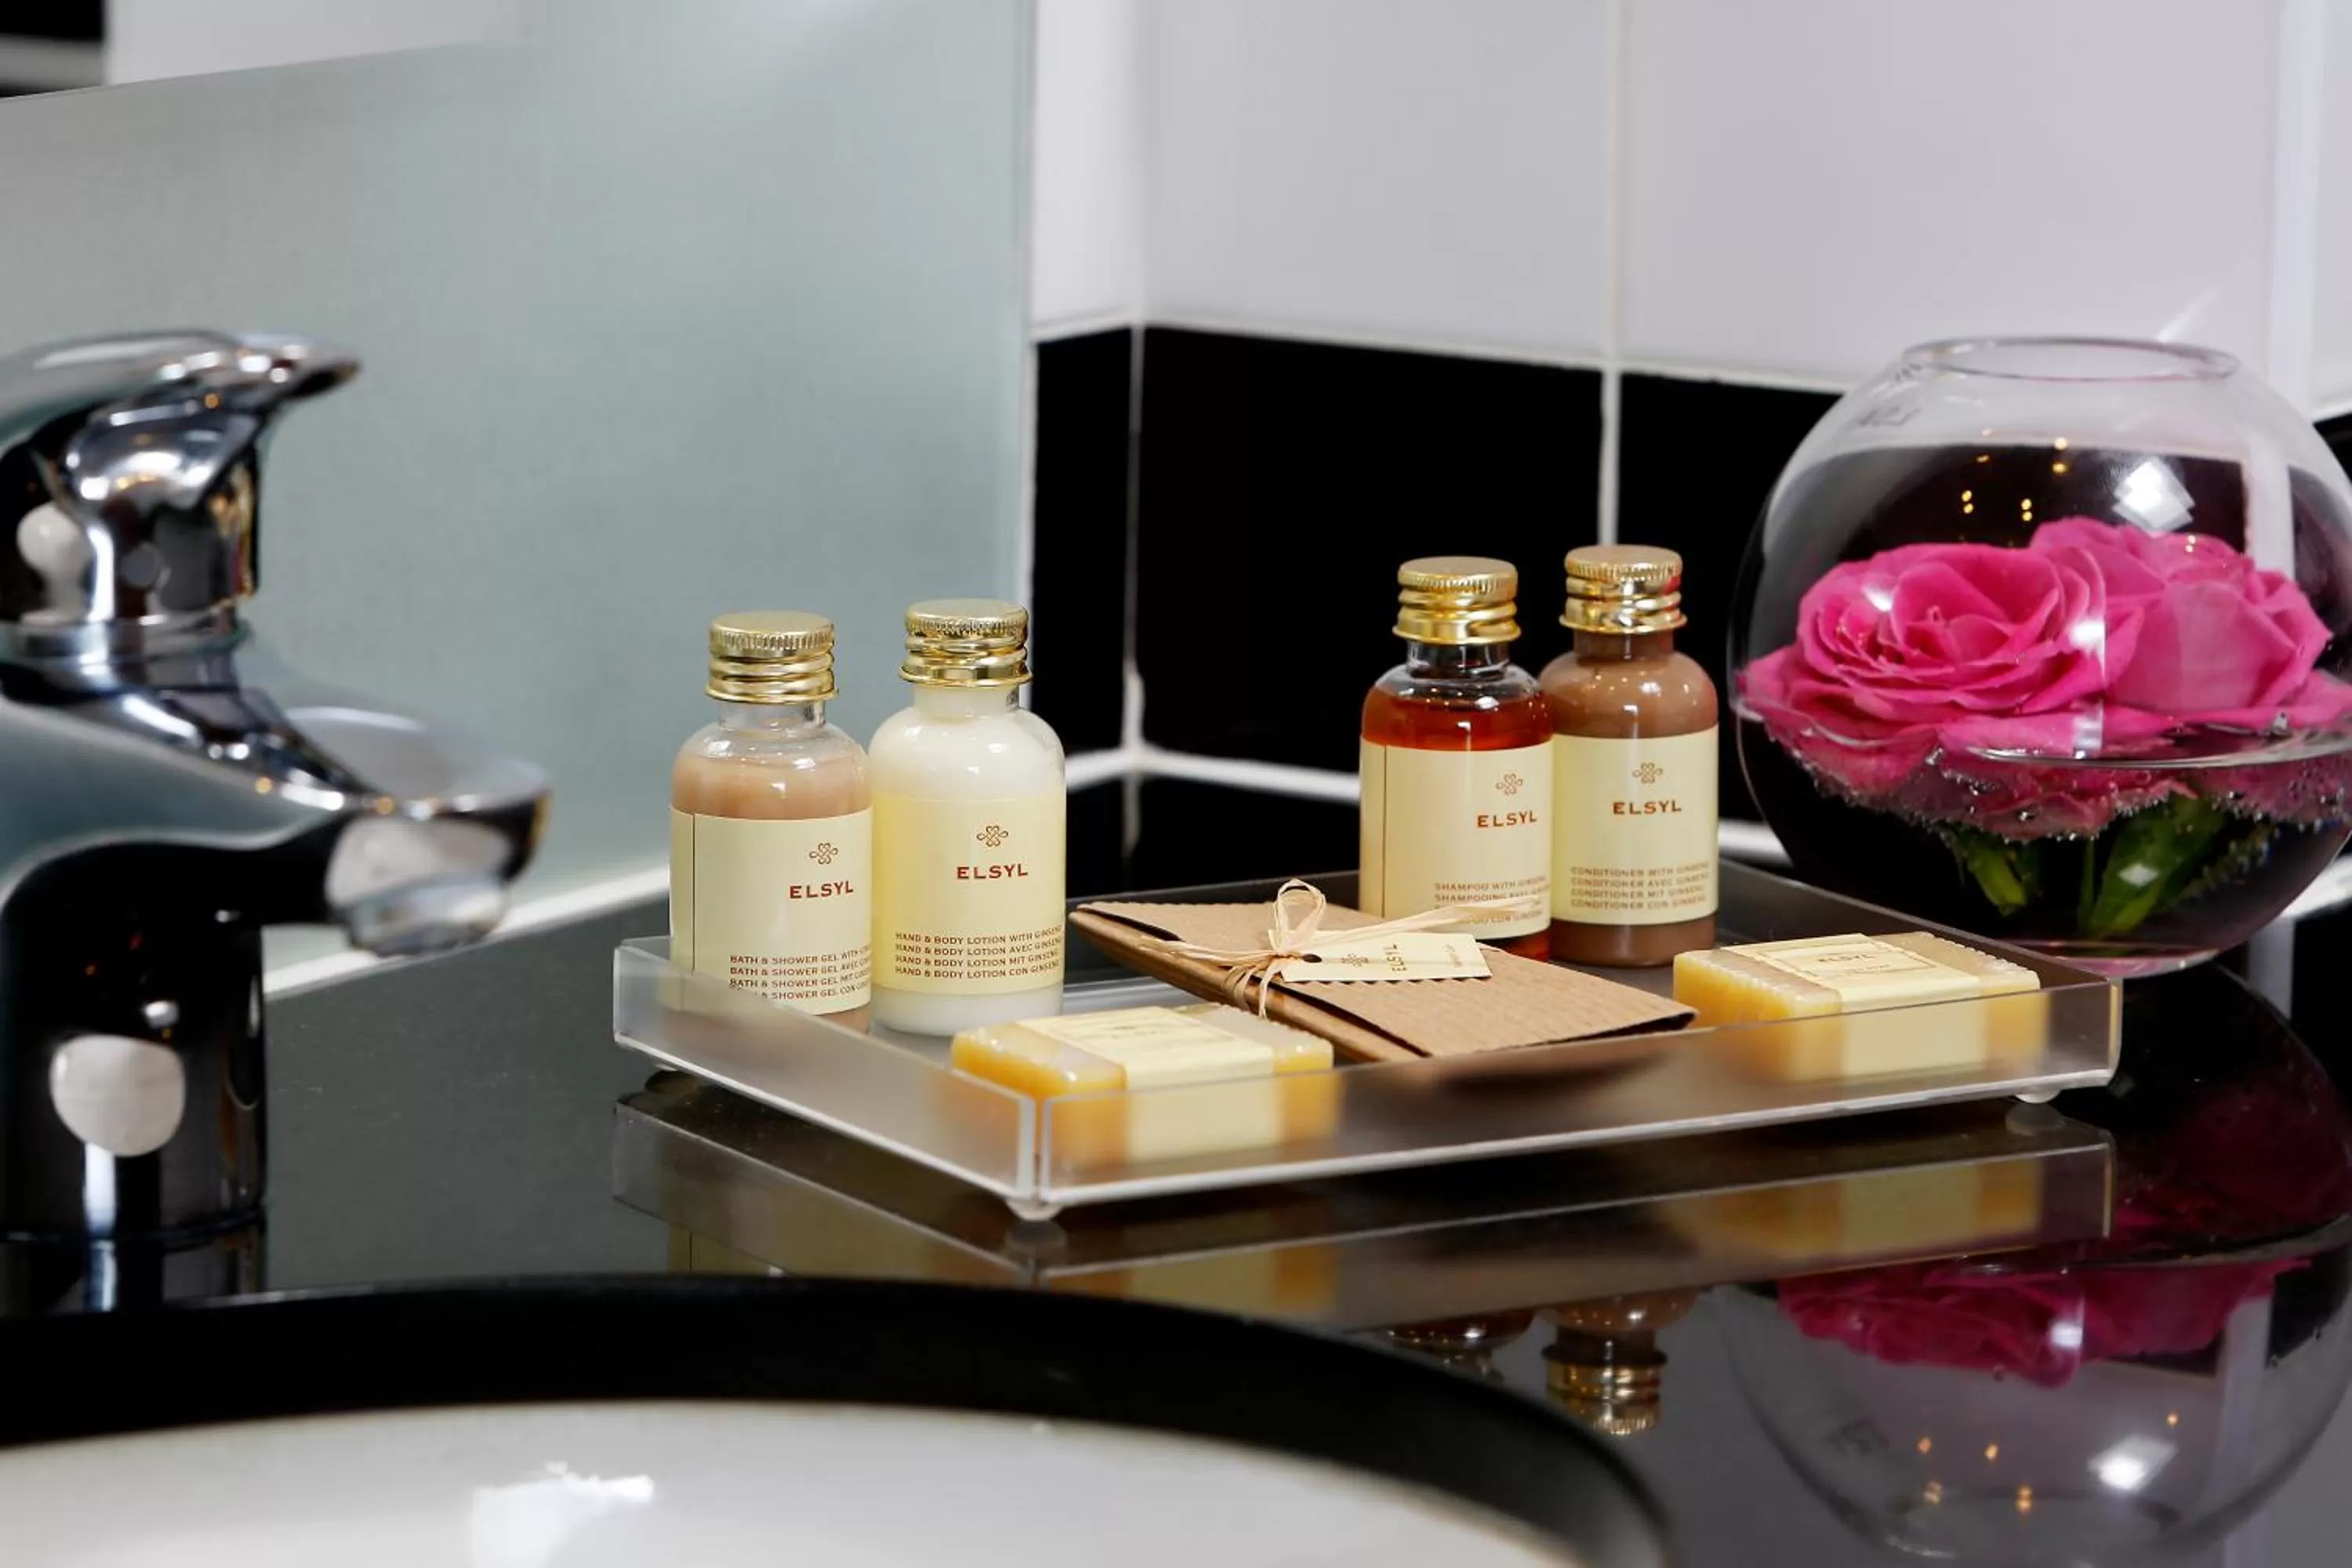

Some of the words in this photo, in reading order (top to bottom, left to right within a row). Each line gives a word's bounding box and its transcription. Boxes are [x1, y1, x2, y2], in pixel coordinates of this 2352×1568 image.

[1613, 800, 1682, 815] ELSYL
[1477, 810, 1537, 828] ELSYL
[956, 863, 1028, 879] ELSYL
[1570, 866, 1645, 877] CONDITIONER
[1435, 882, 1489, 891] SHAMPOO
[1492, 881, 1515, 891] WITH
[1570, 877, 1645, 887] CONDITIONER
[789, 880, 854, 899] ELSYL
[1570, 888, 1645, 898] CONDITIONER
[1570, 899, 1645, 909] CONDITIONER
[1647, 900, 1669, 909] CON
[895, 931, 921, 942] HAND
[935, 936, 964, 945] BODY
[967, 936, 1006, 945] LOTION
[1010, 933, 1033, 942] WITH
[895, 943, 921, 954] HAND
[935, 947, 964, 956] BODY
[967, 947, 1006, 956] LOTION
[1009, 945, 1033, 954] AVEC
[730, 955, 758, 964] BATH
[771, 956, 818, 964] SHOWER
[821, 953, 837, 962] GEL
[840, 949, 858, 960] WITH
[895, 954, 921, 965] HAND
[730, 967, 758, 976] BATH
[771, 967, 818, 976] SHOWER
[821, 965, 837, 974] GEL
[895, 966, 921, 976] HAND
[935, 970, 964, 978] BODY
[967, 970, 1006, 978] LOTION
[730, 978, 758, 988] BATH
[771, 979, 818, 988] SHOWER
[822, 977, 837, 985] GEL
[771, 990, 818, 1000] SHOWER
[820, 988, 837, 997] GEL
[840, 985, 855, 995] CON
